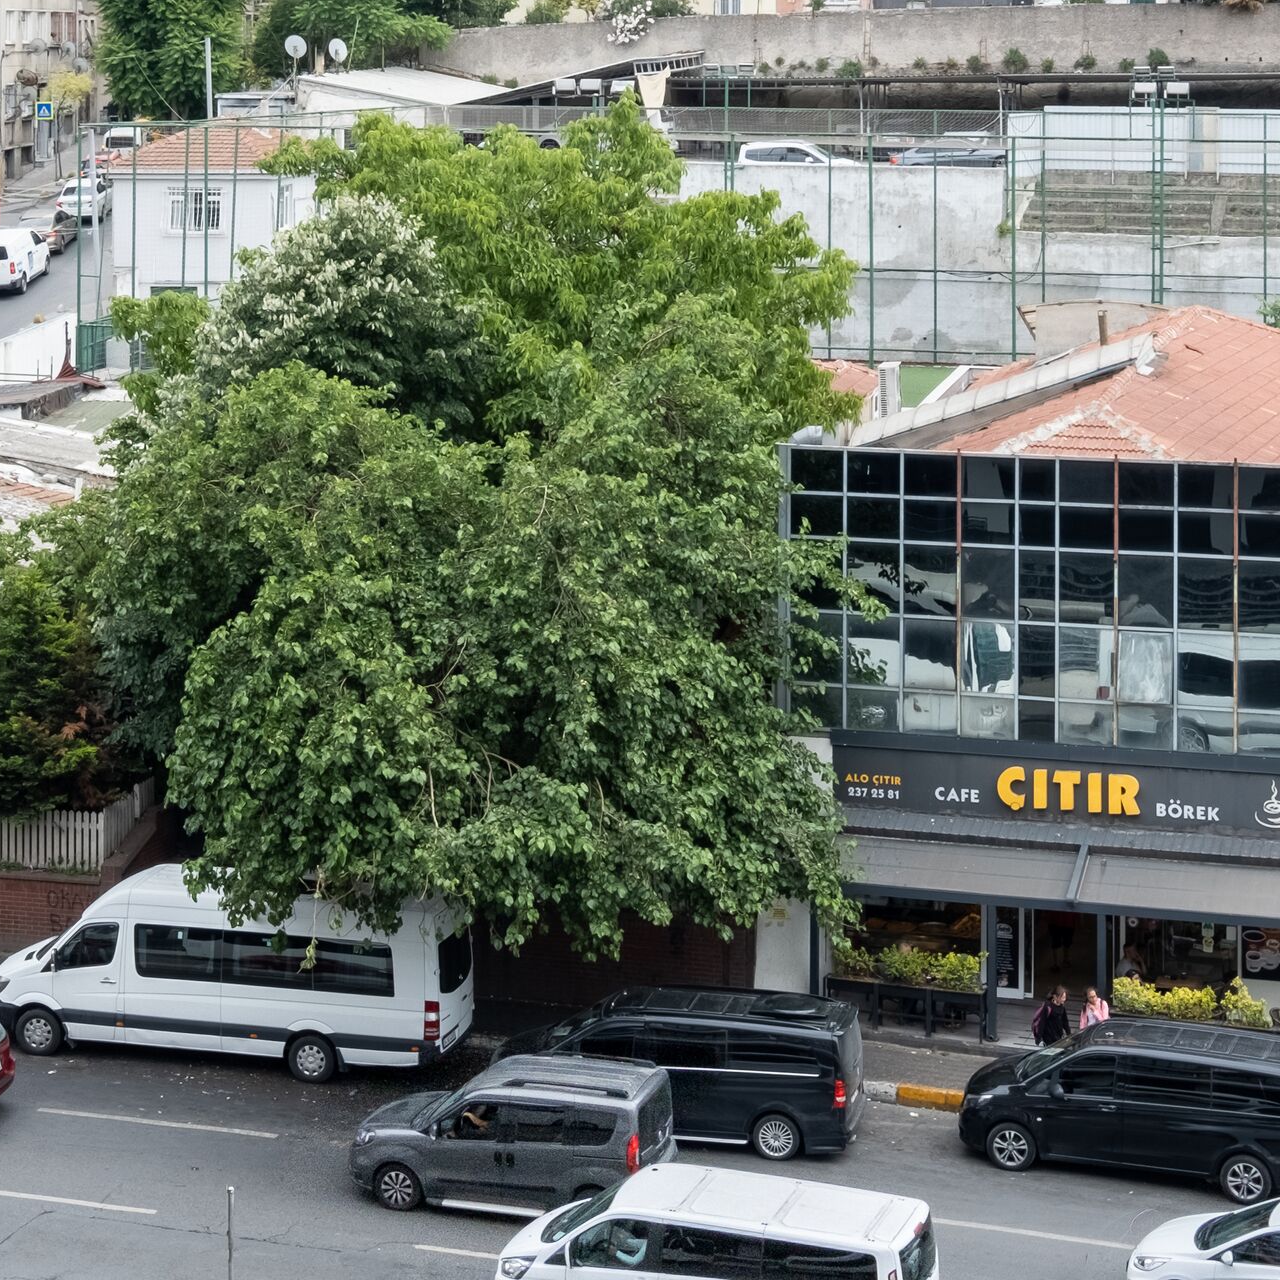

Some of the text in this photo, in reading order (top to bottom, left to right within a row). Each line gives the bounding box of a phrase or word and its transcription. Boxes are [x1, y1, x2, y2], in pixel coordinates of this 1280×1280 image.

[845, 773, 902, 787] ALO ÇITIR
[847, 786, 900, 800] 237 25 81
[934, 786, 980, 803] CAFE
[996, 765, 1141, 816] ÇITIR
[1155, 798, 1220, 821] BÖREK
